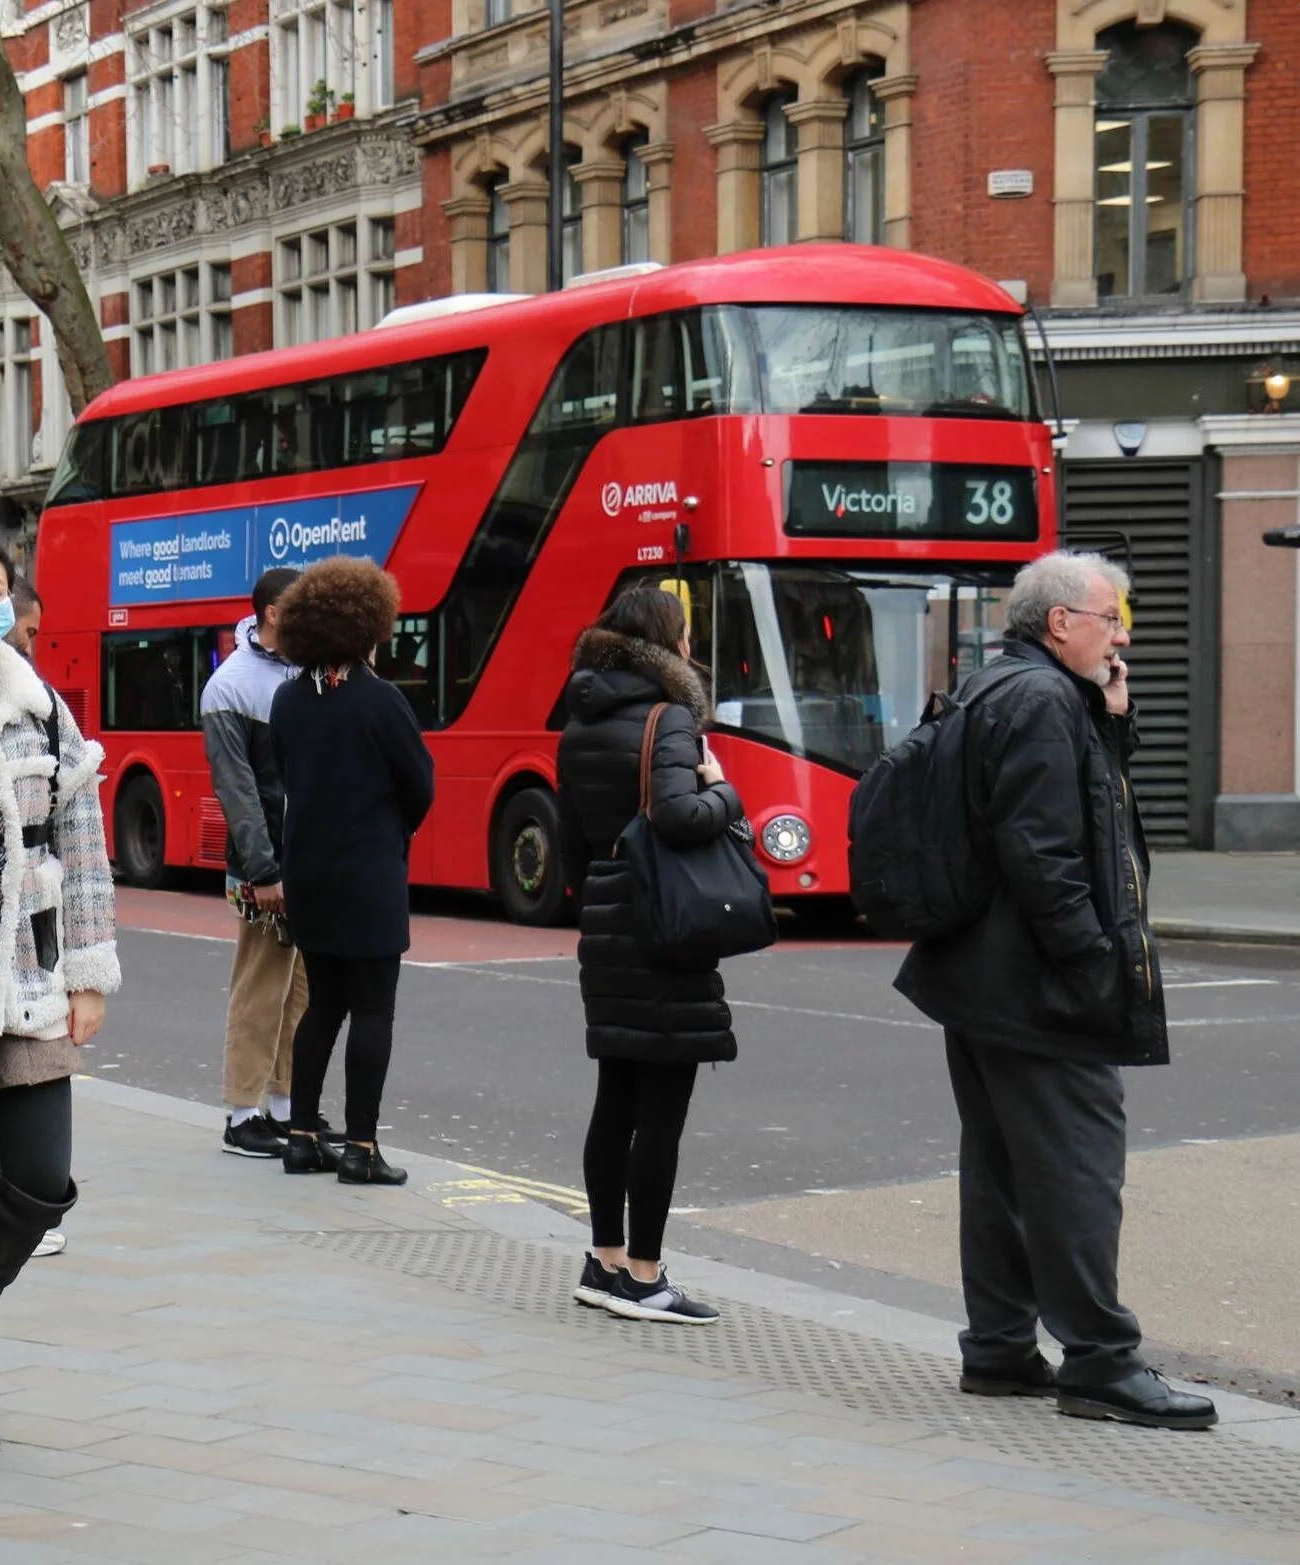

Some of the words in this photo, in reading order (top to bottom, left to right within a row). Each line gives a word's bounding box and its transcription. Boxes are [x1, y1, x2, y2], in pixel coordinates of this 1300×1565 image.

[623, 481, 679, 507] ARRIVA
[821, 483, 916, 514] Victoria
[964, 480, 1015, 526] 38
[119, 539, 152, 560] Where
[153, 533, 179, 561] good
[181, 529, 232, 554] landlords
[291, 515, 367, 553] OpenRent
[637, 545, 664, 561] LT230
[119, 567, 144, 587] meet
[145, 563, 172, 589] good
[172, 560, 213, 582] tenants
